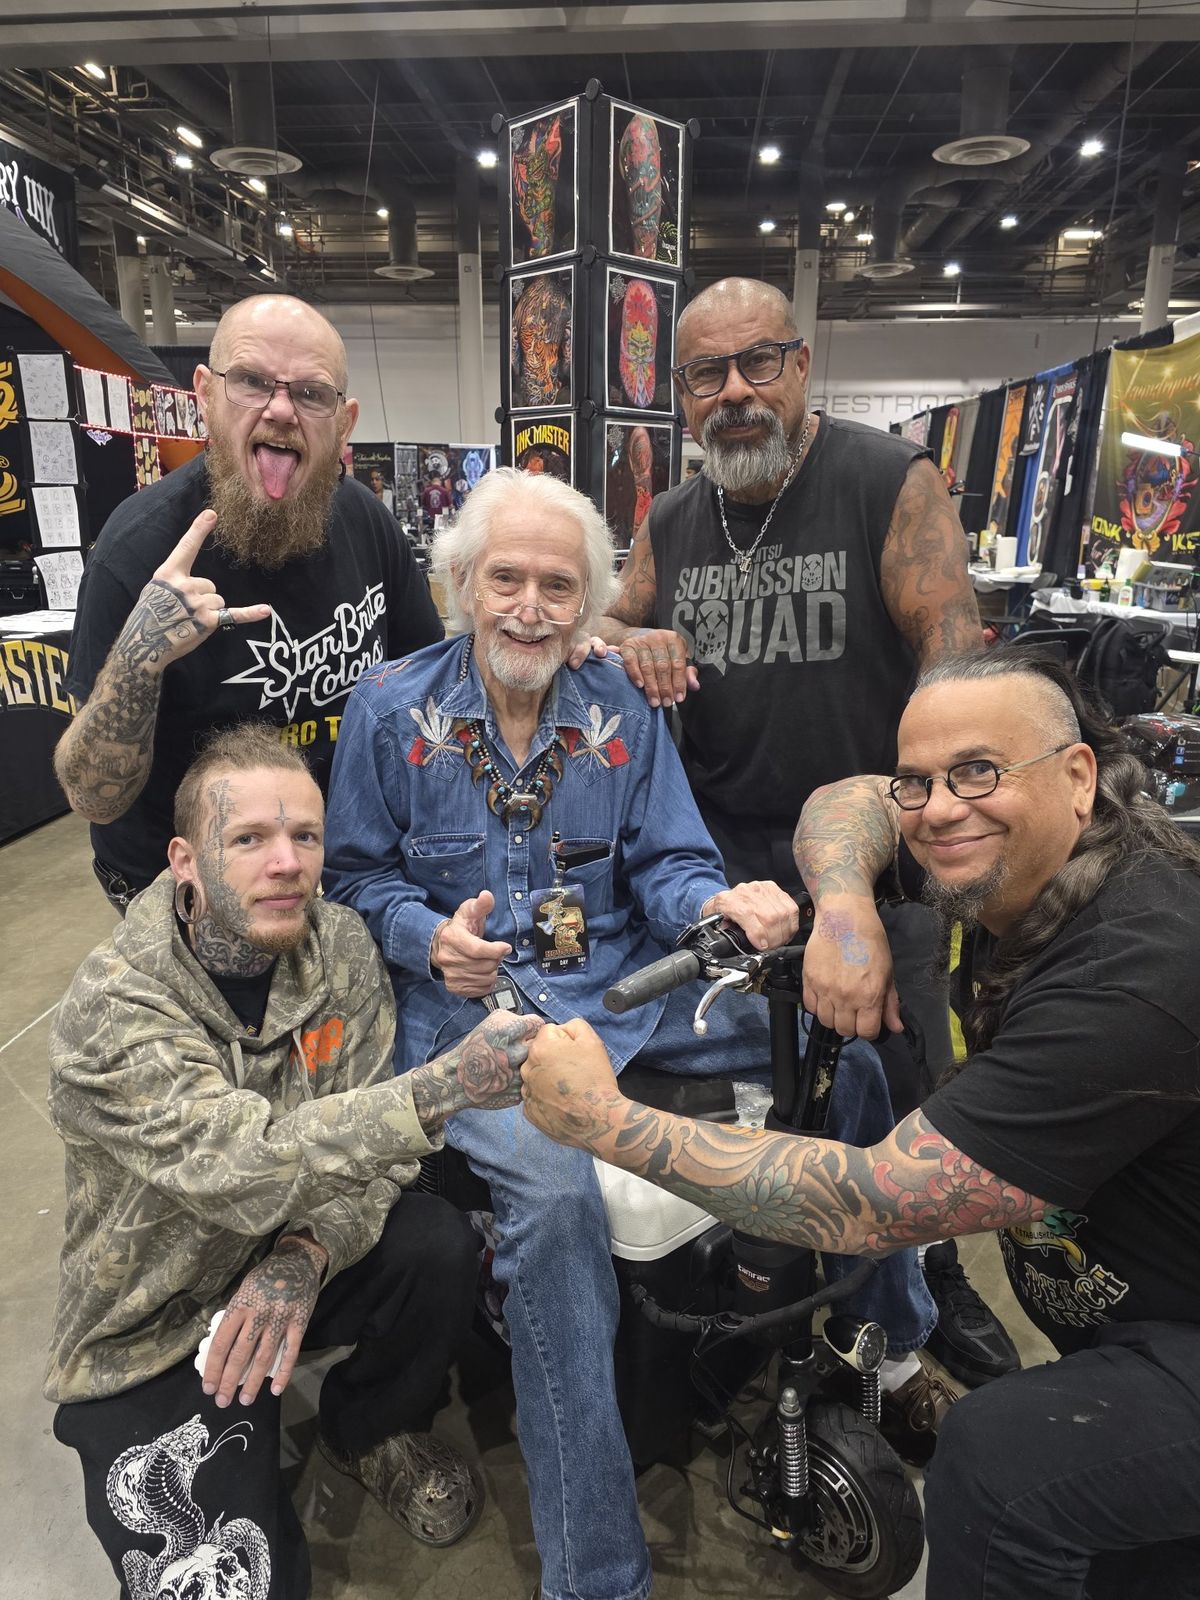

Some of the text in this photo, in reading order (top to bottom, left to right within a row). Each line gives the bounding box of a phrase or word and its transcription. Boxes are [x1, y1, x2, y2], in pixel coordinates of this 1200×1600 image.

[516, 424, 570, 457] INK MASTER
[674, 550, 848, 602] SUBMISSION
[672, 590, 847, 677] SQUAD
